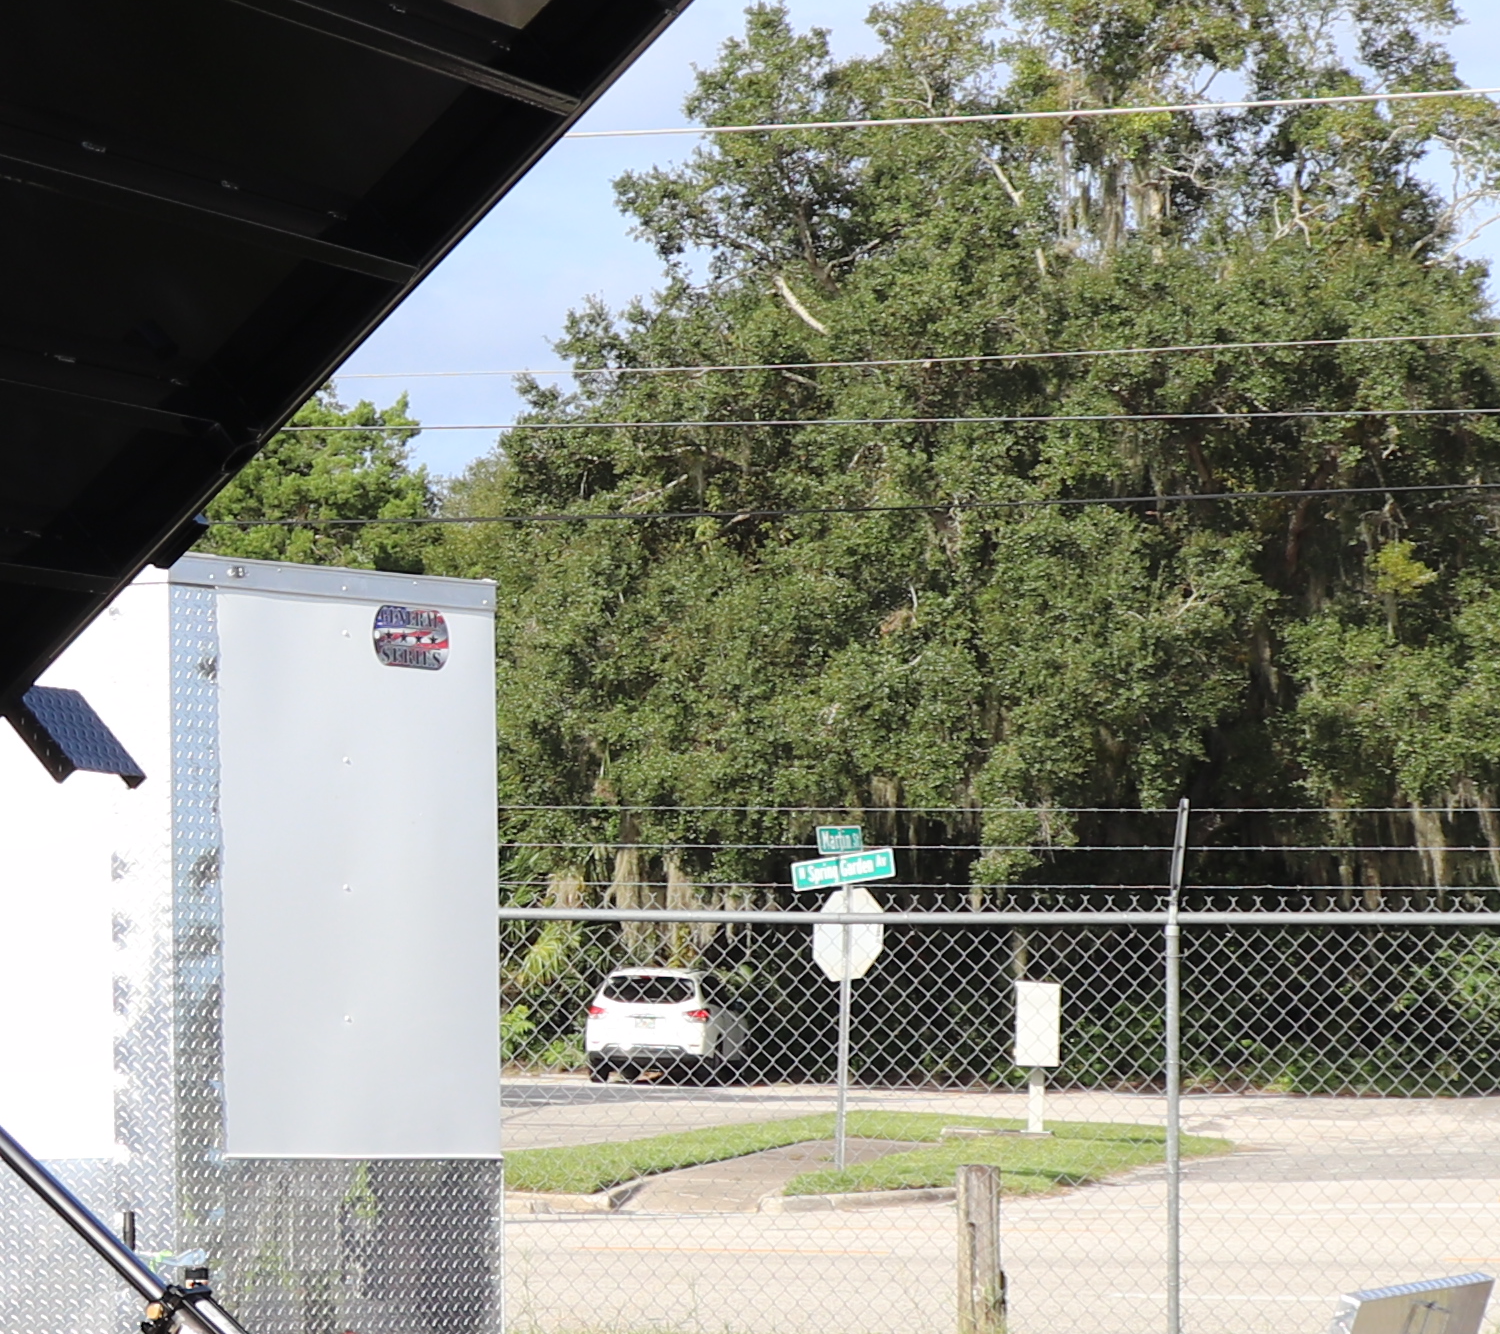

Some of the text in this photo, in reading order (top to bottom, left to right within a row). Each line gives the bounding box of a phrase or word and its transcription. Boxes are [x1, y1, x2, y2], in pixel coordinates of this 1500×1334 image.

[381, 647, 442, 667] SERIES
[807, 864, 839, 884] Spring
[840, 857, 875, 877] Garden
